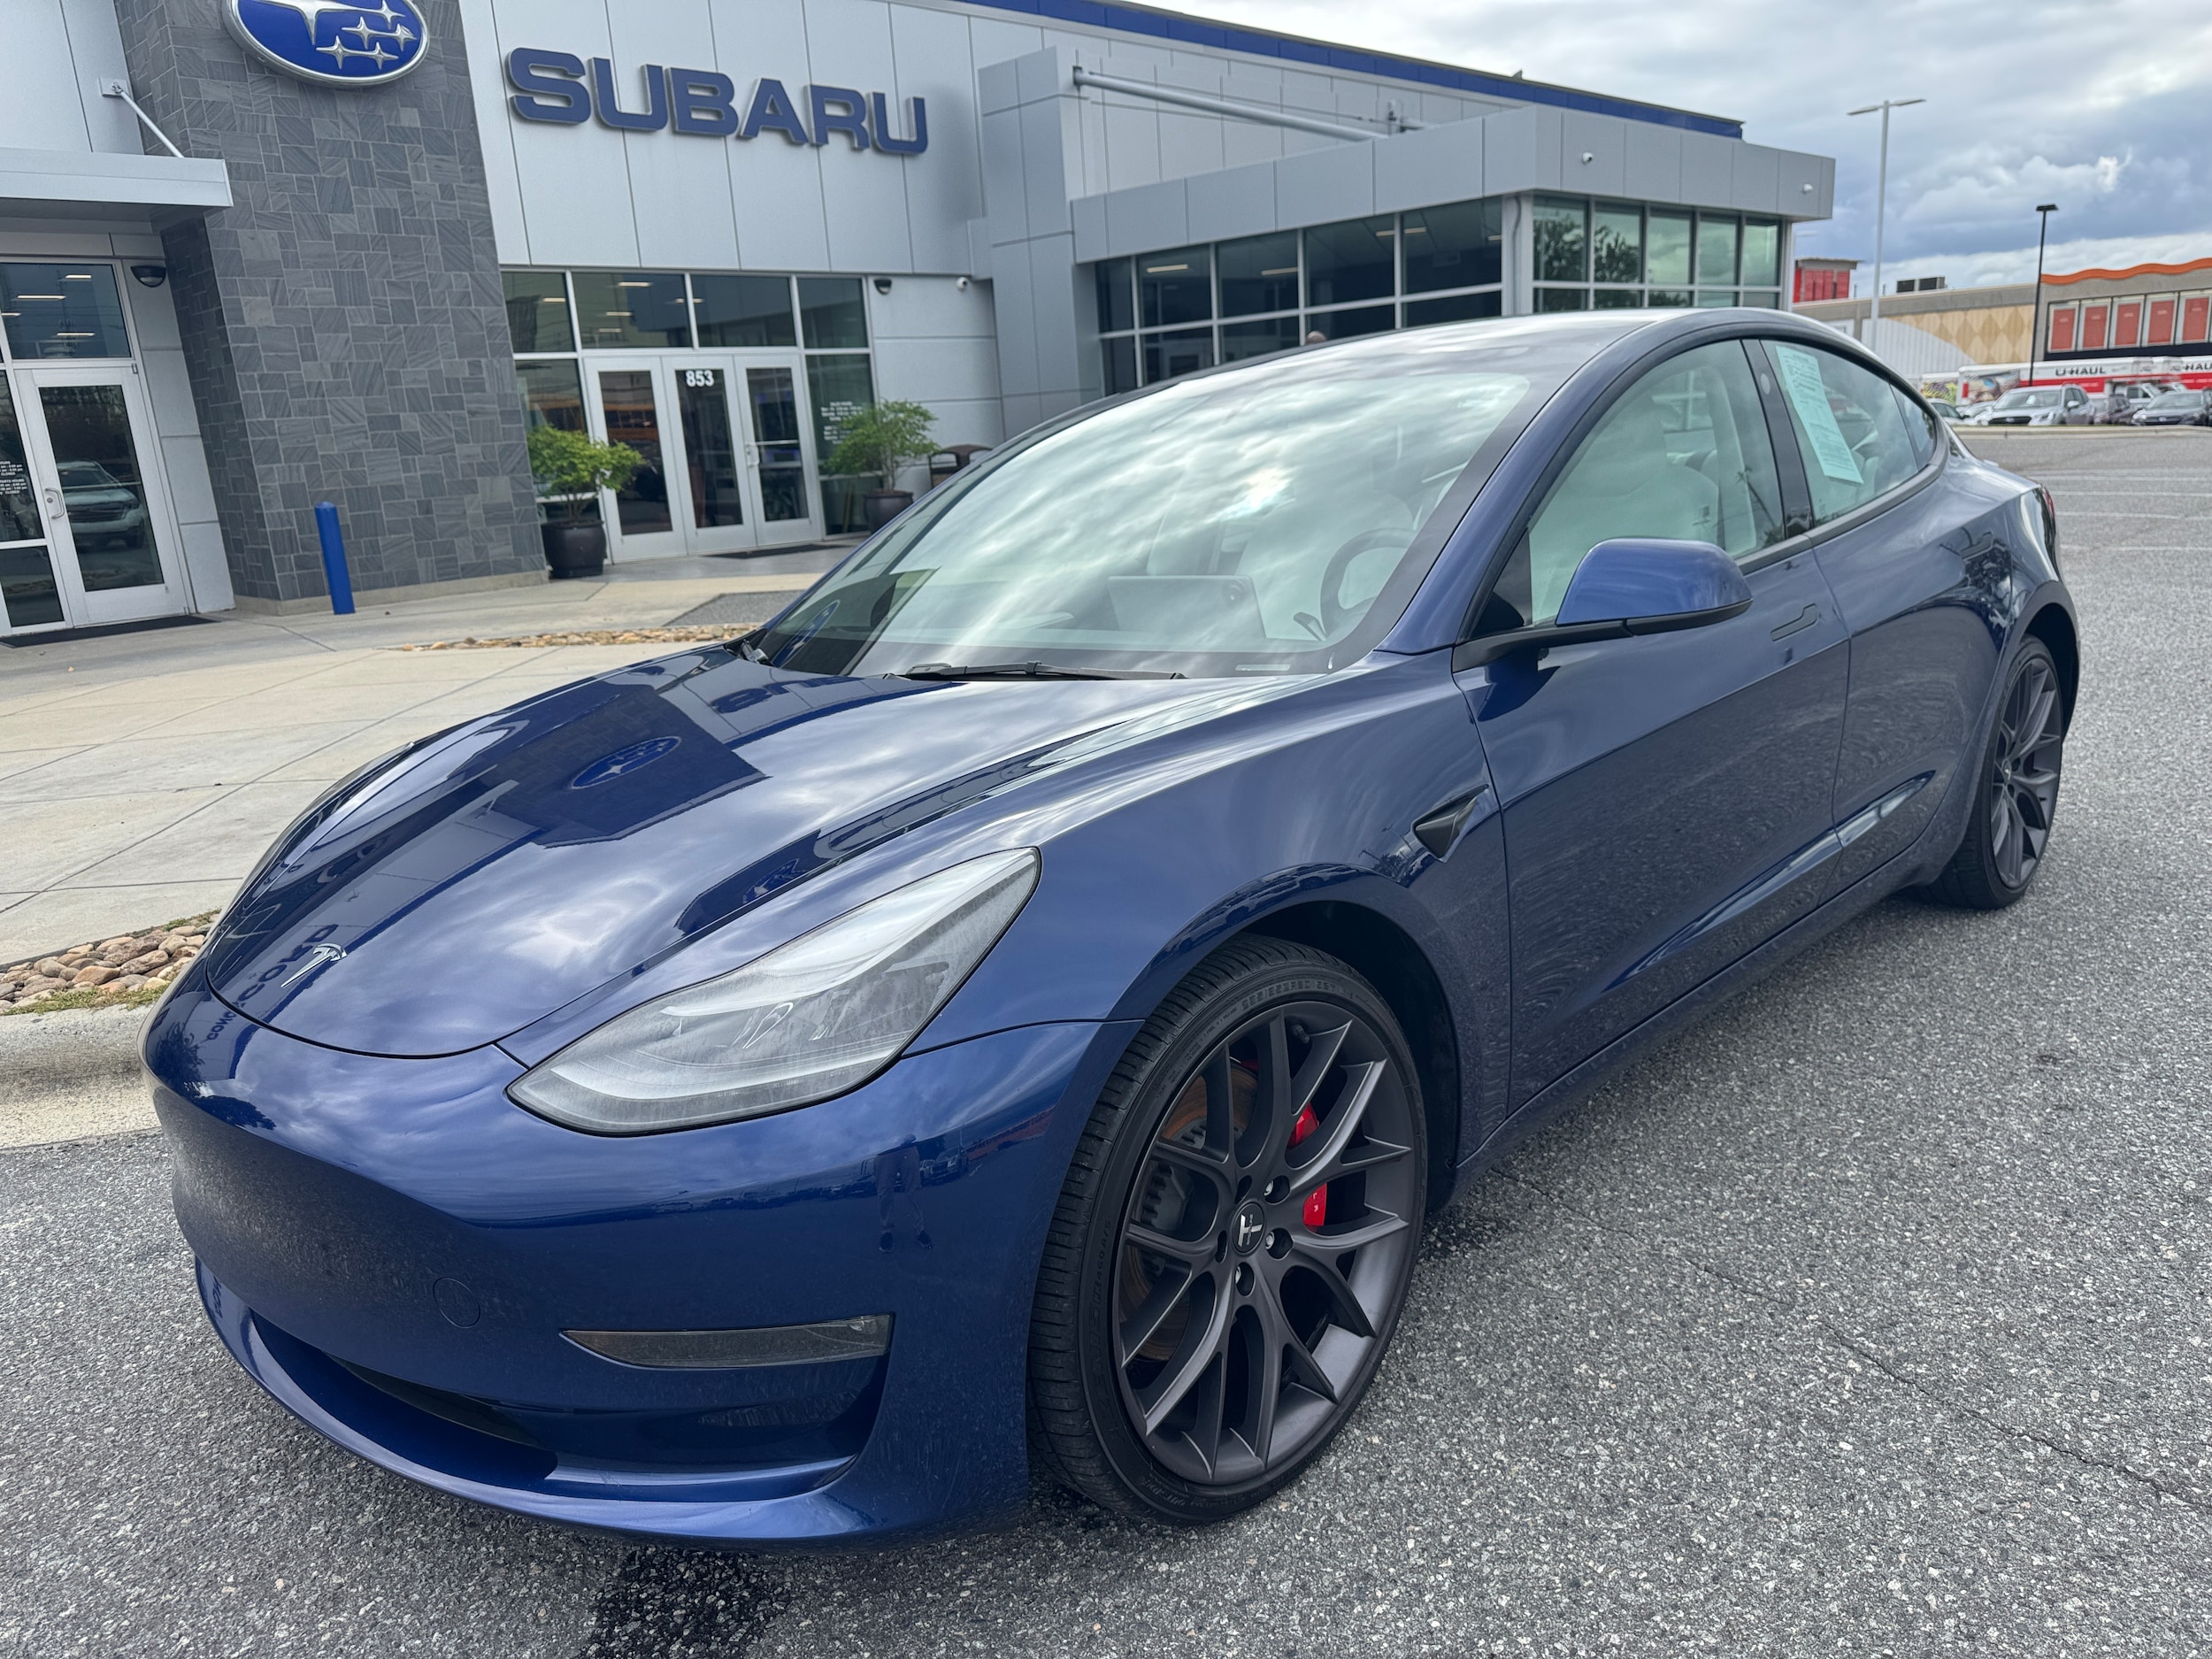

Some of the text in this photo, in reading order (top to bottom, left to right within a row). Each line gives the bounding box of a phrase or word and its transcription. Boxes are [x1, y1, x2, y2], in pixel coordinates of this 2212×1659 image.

[506, 47, 929, 155] SUBARU
[686, 370, 715, 387] 853
[2055, 365, 2107, 376] U-HAUL
